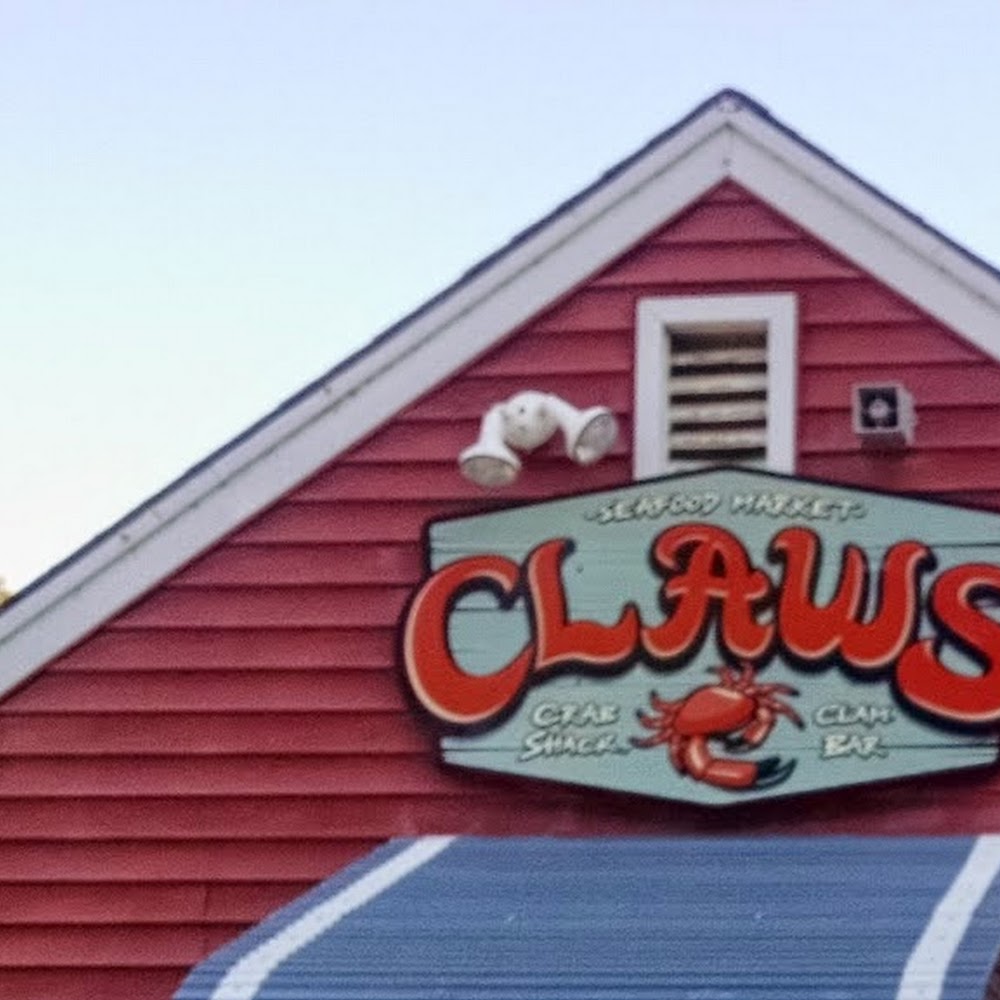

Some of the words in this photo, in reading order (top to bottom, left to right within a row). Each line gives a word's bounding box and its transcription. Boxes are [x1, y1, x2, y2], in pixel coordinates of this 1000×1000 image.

[599, 490, 721, 524] SEAFOOD
[729, 492, 857, 522] MARKET
[533, 702, 620, 728] CRAB
[815, 703, 895, 725] CLAM
[520, 730, 618, 760] SHACK
[823, 734, 888, 759] BAR
